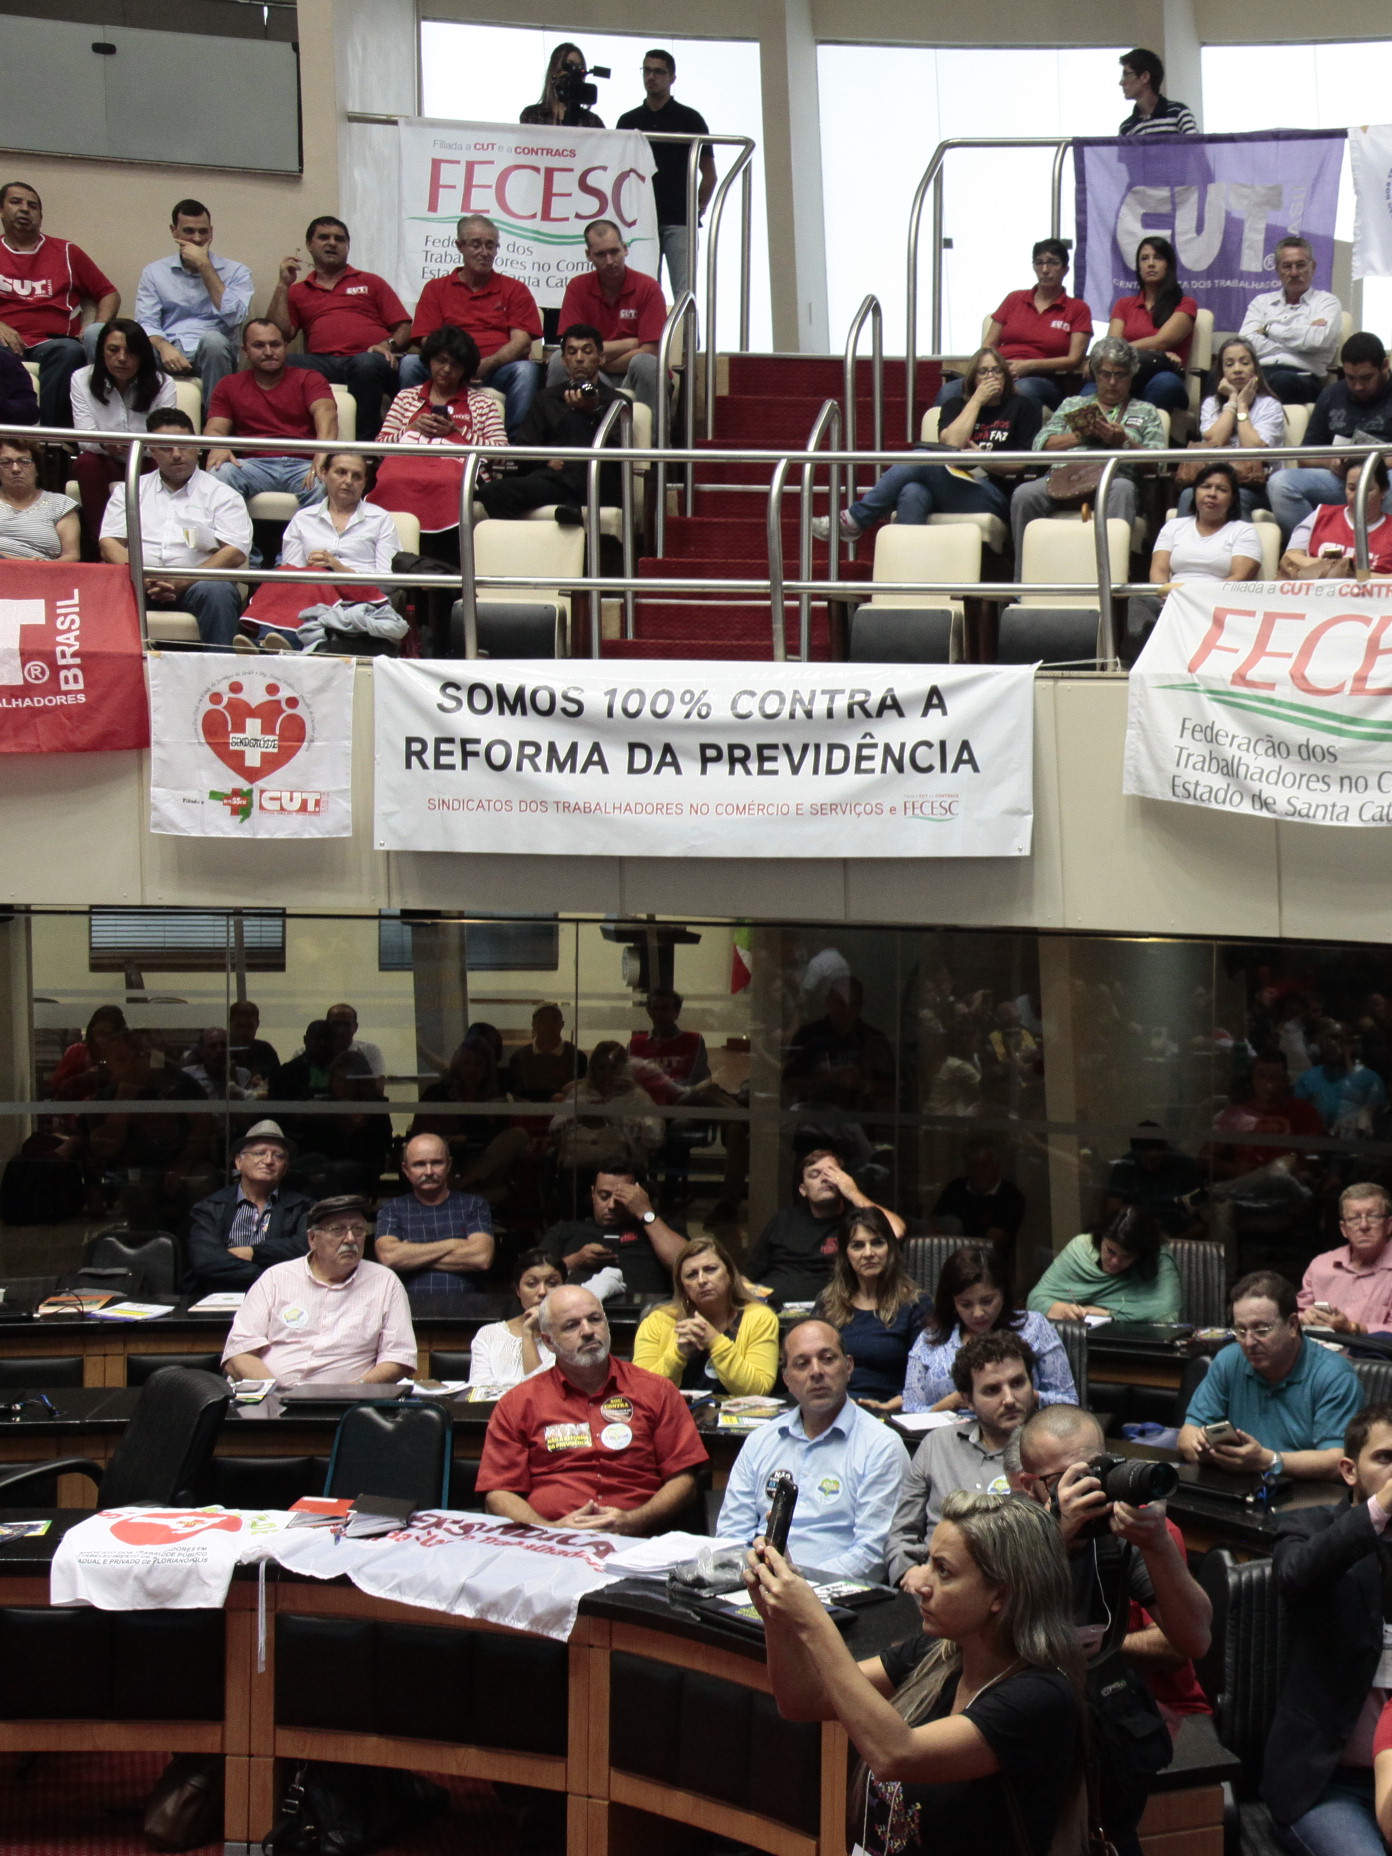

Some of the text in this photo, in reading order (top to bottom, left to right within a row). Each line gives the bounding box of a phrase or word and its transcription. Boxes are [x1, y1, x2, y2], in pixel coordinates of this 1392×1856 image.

[433, 139, 464, 152] Filiada
[465, 143, 472, 151] a
[474, 142, 497, 152] CUT
[514, 145, 576, 159] CONTRACS
[427, 157, 646, 228] FECESC
[1116, 182, 1283, 272] CUT
[506, 241, 534, 256] dos
[531, 261, 551, 272] no
[1215, 279, 1283, 290] TRABALHADO
[990, 430, 1009, 442] FAZ
[1267, 584, 1276, 595] a
[1279, 582, 1315, 597] CUT
[1315, 586, 1324, 597] e
[1326, 586, 1336, 598] a
[56, 588, 85, 691] BRASIL
[0, 693, 86, 708] LHADORES
[436, 681, 949, 720] SOMOS 100% CONTRA A
[404, 731, 981, 777] REFORMA DA PREVIDÊNCIA
[1178, 717, 1338, 764] Federação dos
[1173, 745, 1332, 793] Trabalhadores
[1339, 774, 1369, 795] no
[427, 797, 960, 819] SINDICATOS DOS TRABALHADORES NO COMÉRCIO E SERVIÇOS e FECESC
[1171, 774, 1244, 808] Estado
[1251, 789, 1277, 814] de
[1284, 795, 1350, 822] Santa
